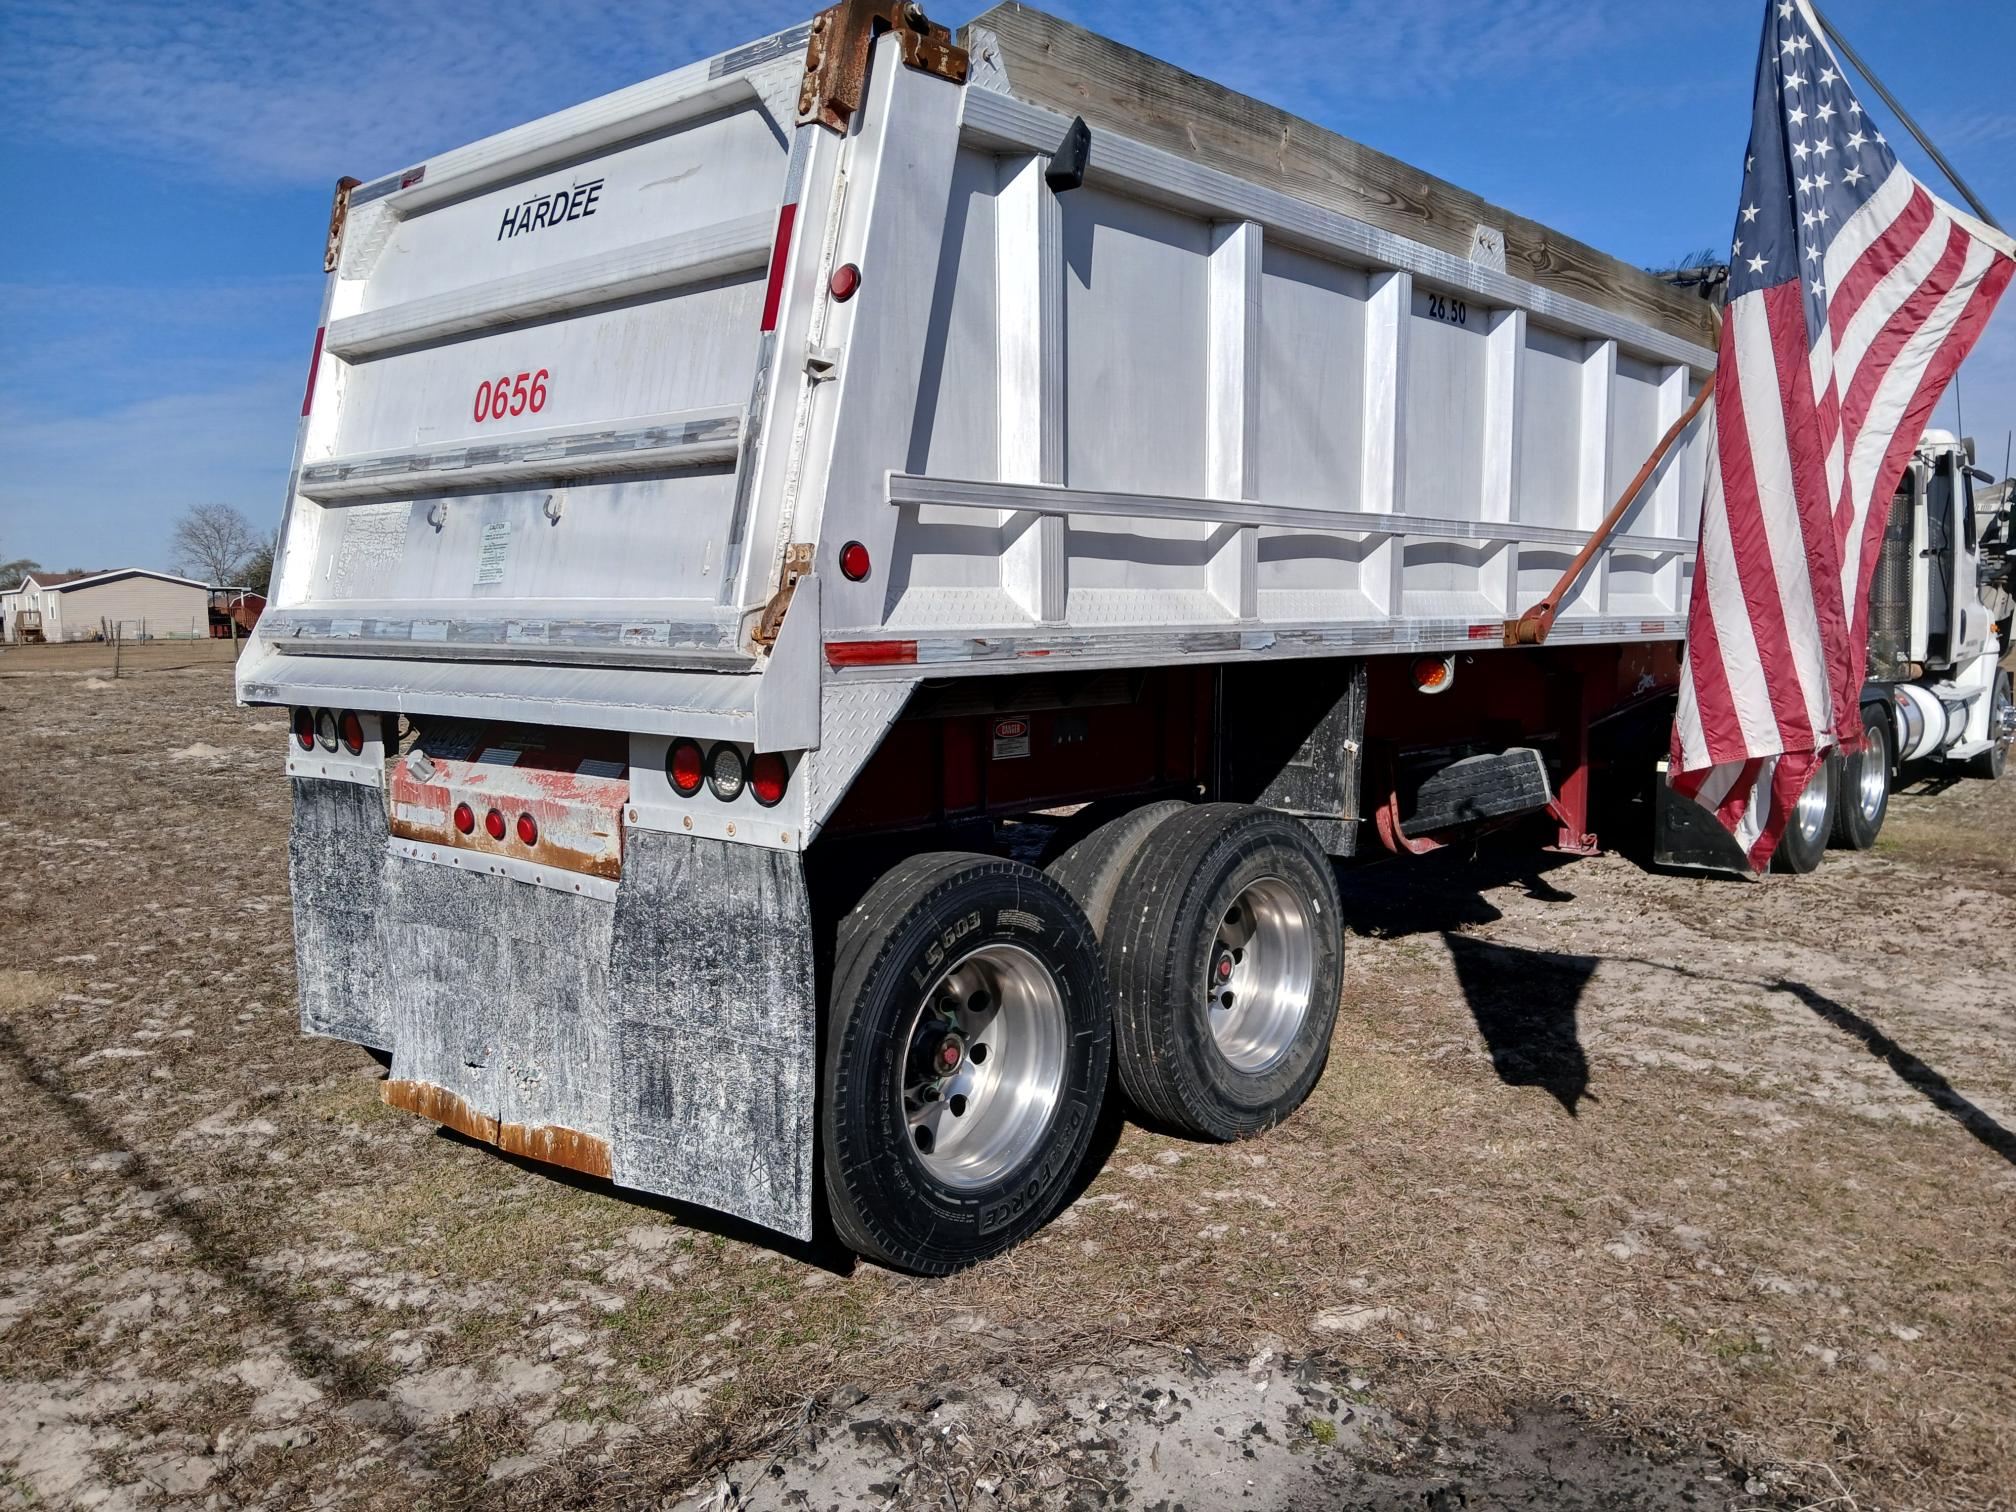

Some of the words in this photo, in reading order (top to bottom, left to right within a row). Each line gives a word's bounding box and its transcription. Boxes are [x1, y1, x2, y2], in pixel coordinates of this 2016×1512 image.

[497, 178, 604, 241] HARDEE
[1429, 293, 1466, 324] 26.50
[473, 368, 549, 423] 0656
